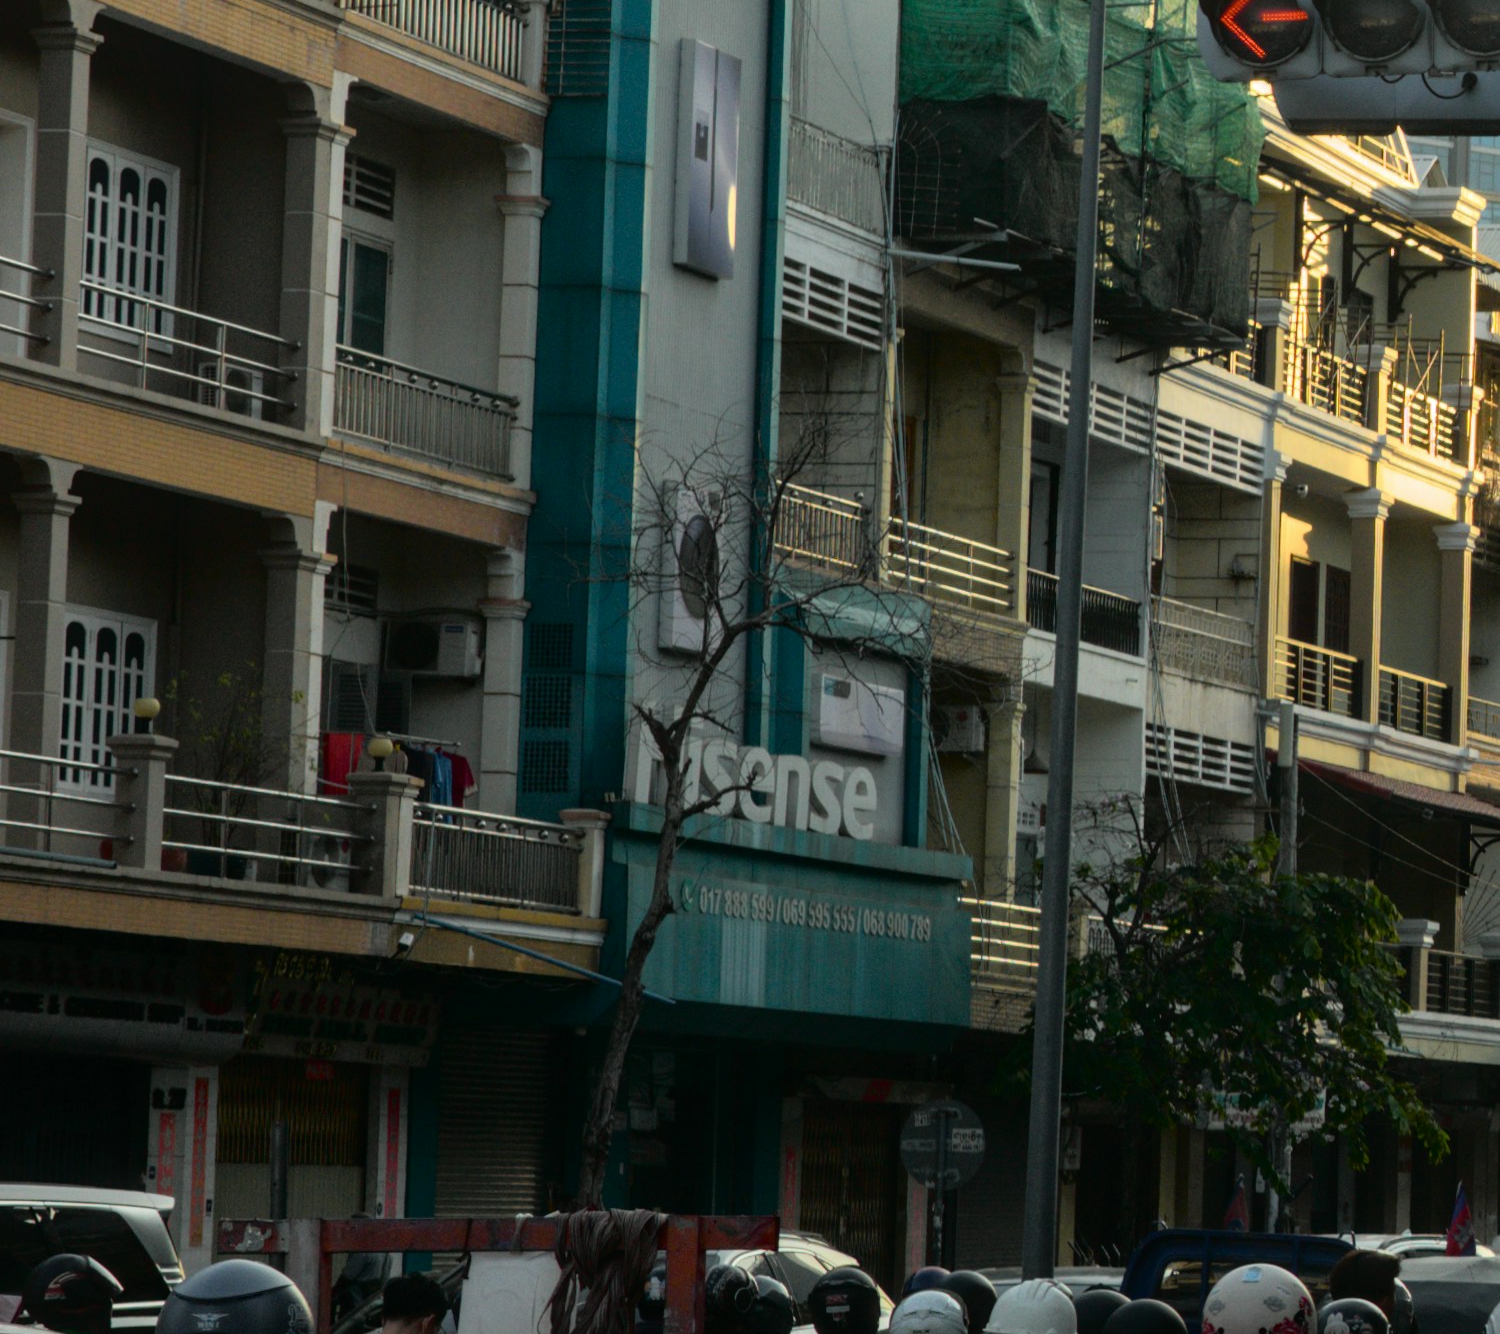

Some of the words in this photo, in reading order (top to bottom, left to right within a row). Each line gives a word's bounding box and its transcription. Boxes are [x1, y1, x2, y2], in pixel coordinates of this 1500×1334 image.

[700, 889, 719, 915] 017
[724, 890, 749, 918] 888
[751, 895, 774, 921] 599
[783, 899, 806, 926] 069
[808, 902, 832, 929] 595
[834, 905, 856, 932] 555
[863, 909, 886, 935] 068
[887, 911, 910, 938] 900
[910, 915, 932, 941] 789
